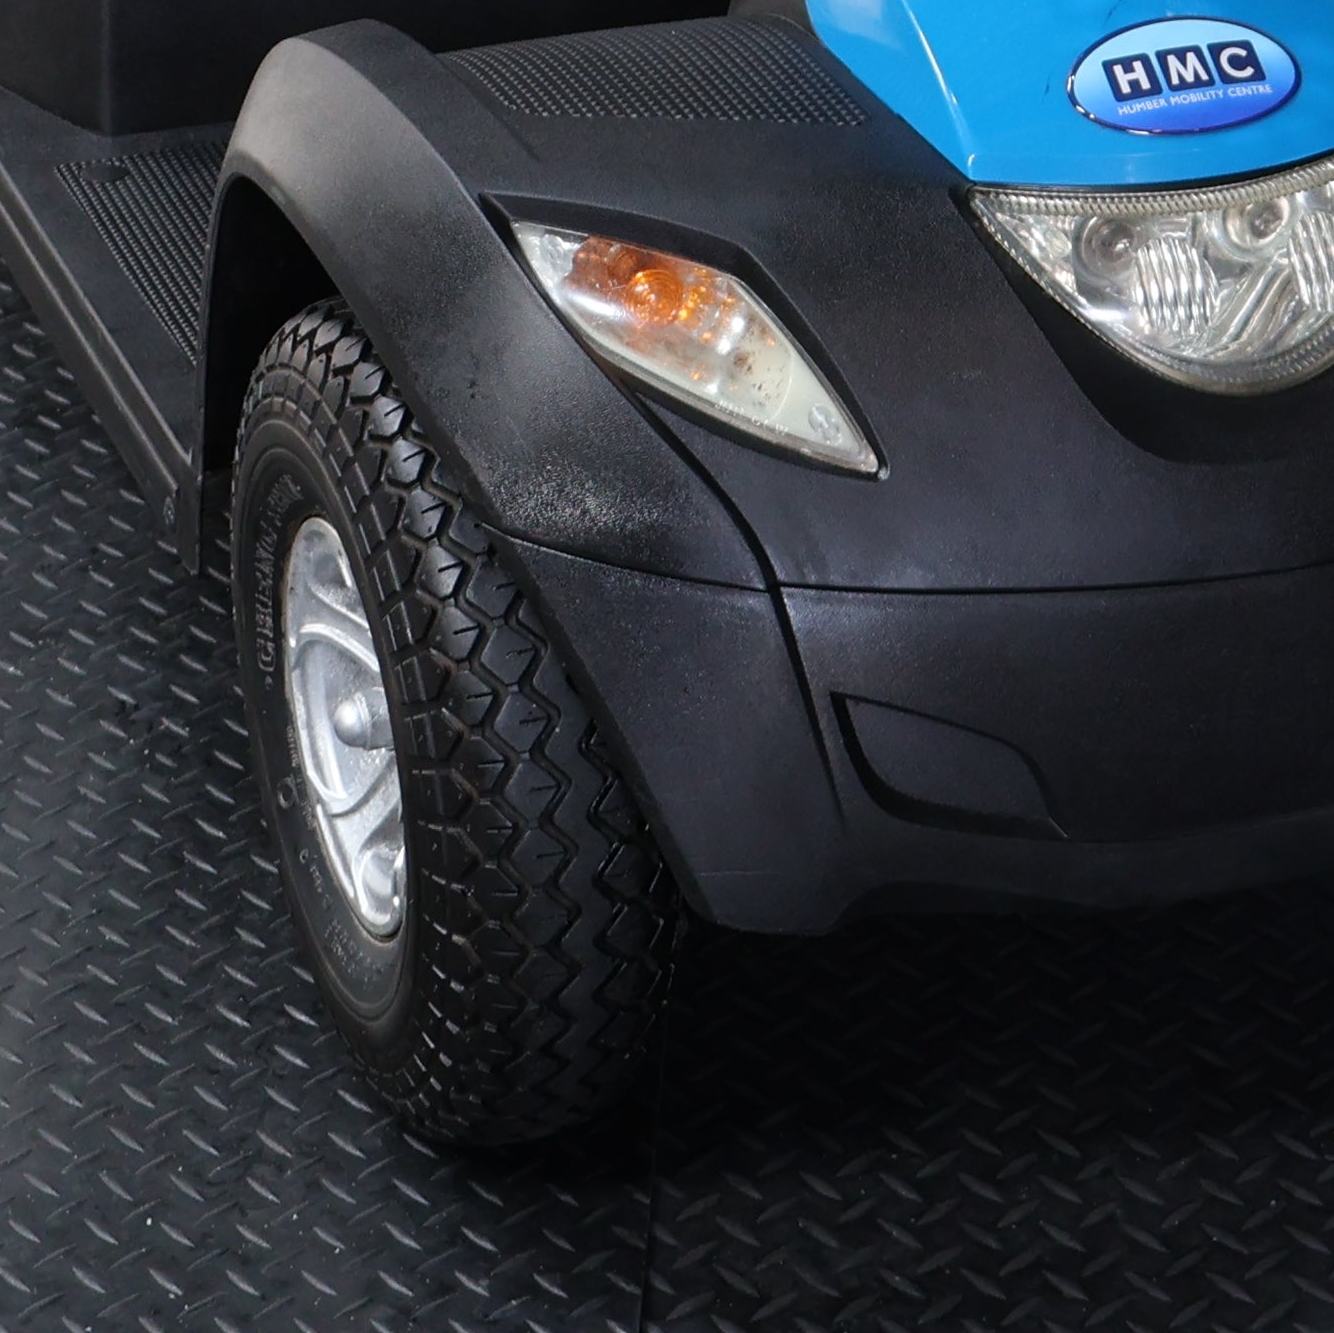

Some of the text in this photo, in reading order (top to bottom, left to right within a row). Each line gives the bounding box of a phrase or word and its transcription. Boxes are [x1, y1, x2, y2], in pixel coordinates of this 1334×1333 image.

[1110, 45, 1257, 95] HMC
[1118, 83, 1273, 116] HUMBER MOBILITY CENTRE
